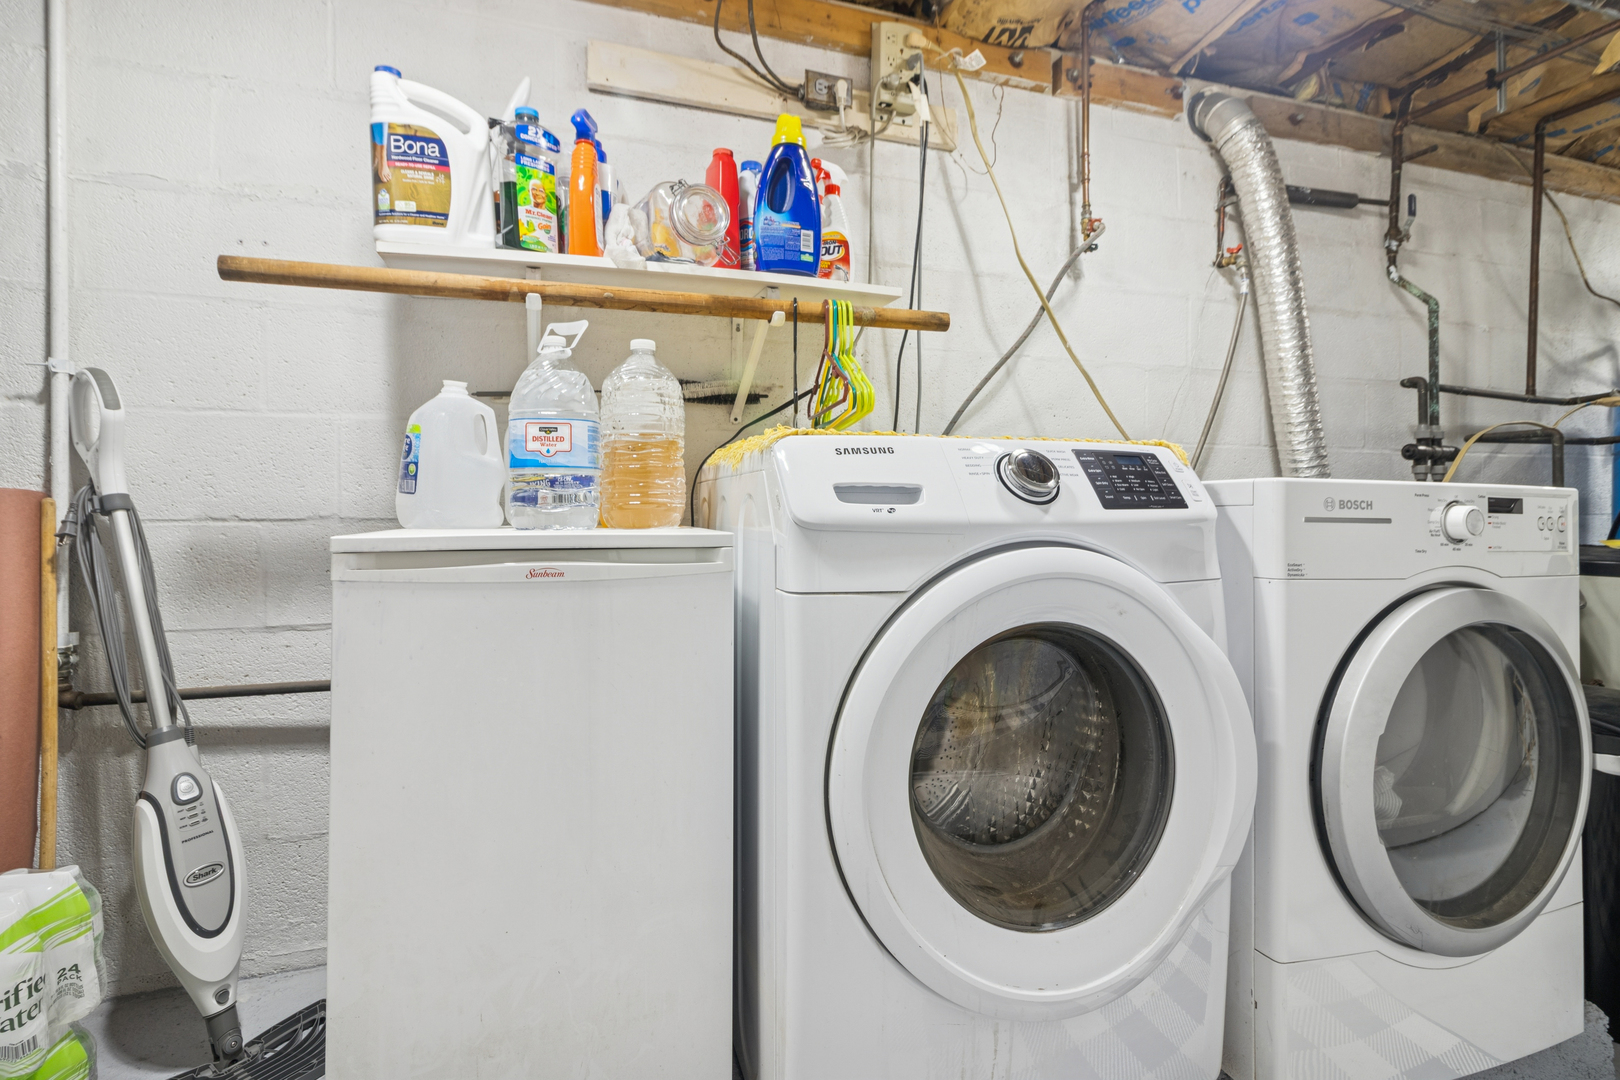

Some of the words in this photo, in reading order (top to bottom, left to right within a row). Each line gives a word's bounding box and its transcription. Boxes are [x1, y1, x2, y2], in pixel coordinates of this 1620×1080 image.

[390, 135, 441, 157] Bona
[525, 208, 537, 216] Mr.
[537, 211, 553, 221] Clean
[538, 222, 552, 231] Gain
[821, 245, 843, 256] OUT
[532, 435, 565, 443] DISTILLED
[834, 446, 895, 455] SAMSUNG
[1338, 499, 1374, 510] BOSCH
[525, 568, 566, 580] Sunbeam
[181, 830, 214, 844] PROFESSIONAL
[193, 866, 218, 882] Shark
[57, 963, 81, 979] 24
[57, 973, 83, 985] PACK
[0, 973, 46, 1012] ifie
[0, 998, 43, 1033] ater
